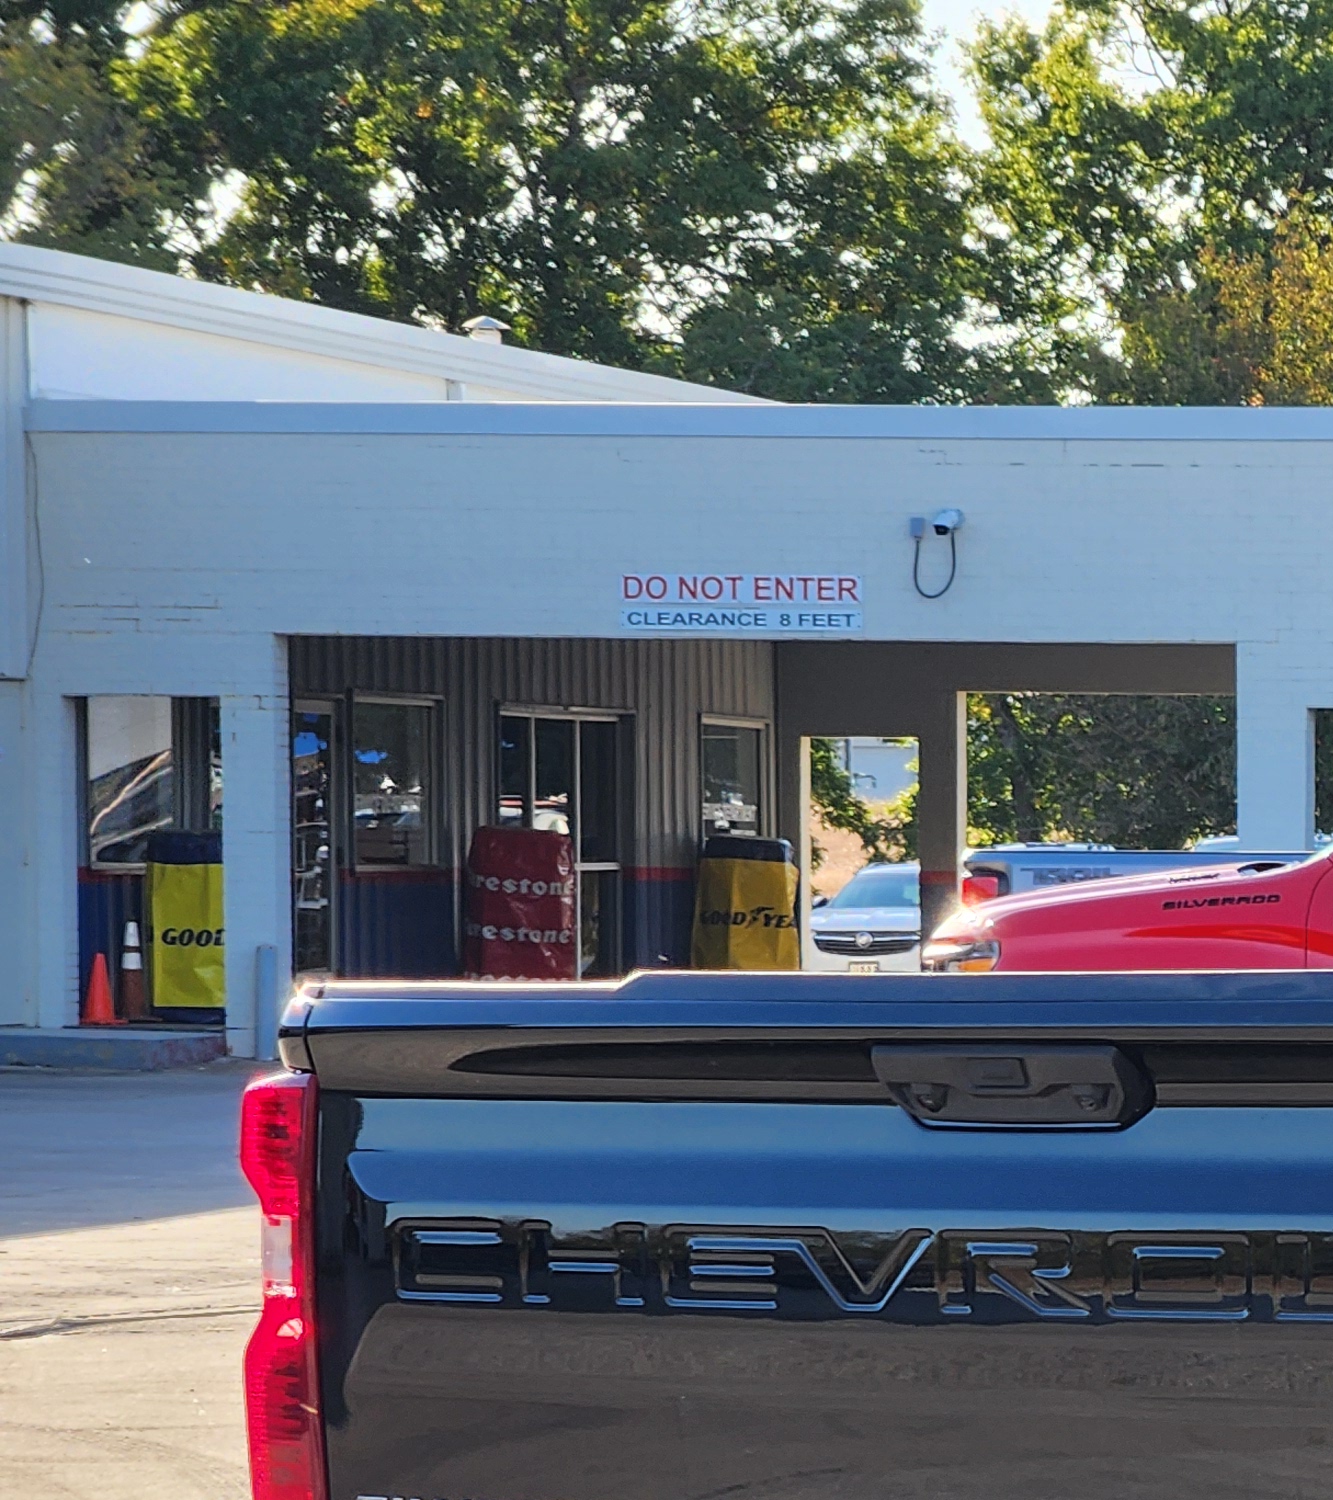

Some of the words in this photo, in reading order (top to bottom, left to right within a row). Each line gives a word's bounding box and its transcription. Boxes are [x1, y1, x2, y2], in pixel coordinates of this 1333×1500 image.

[622, 575, 668, 601] DO
[678, 576, 744, 601] NOT
[753, 576, 860, 602] ENTER
[627, 611, 768, 627] CLEARANCE
[779, 613, 792, 627] 8
[798, 613, 856, 628] FEET
[1162, 894, 1281, 910] SILVERADO
